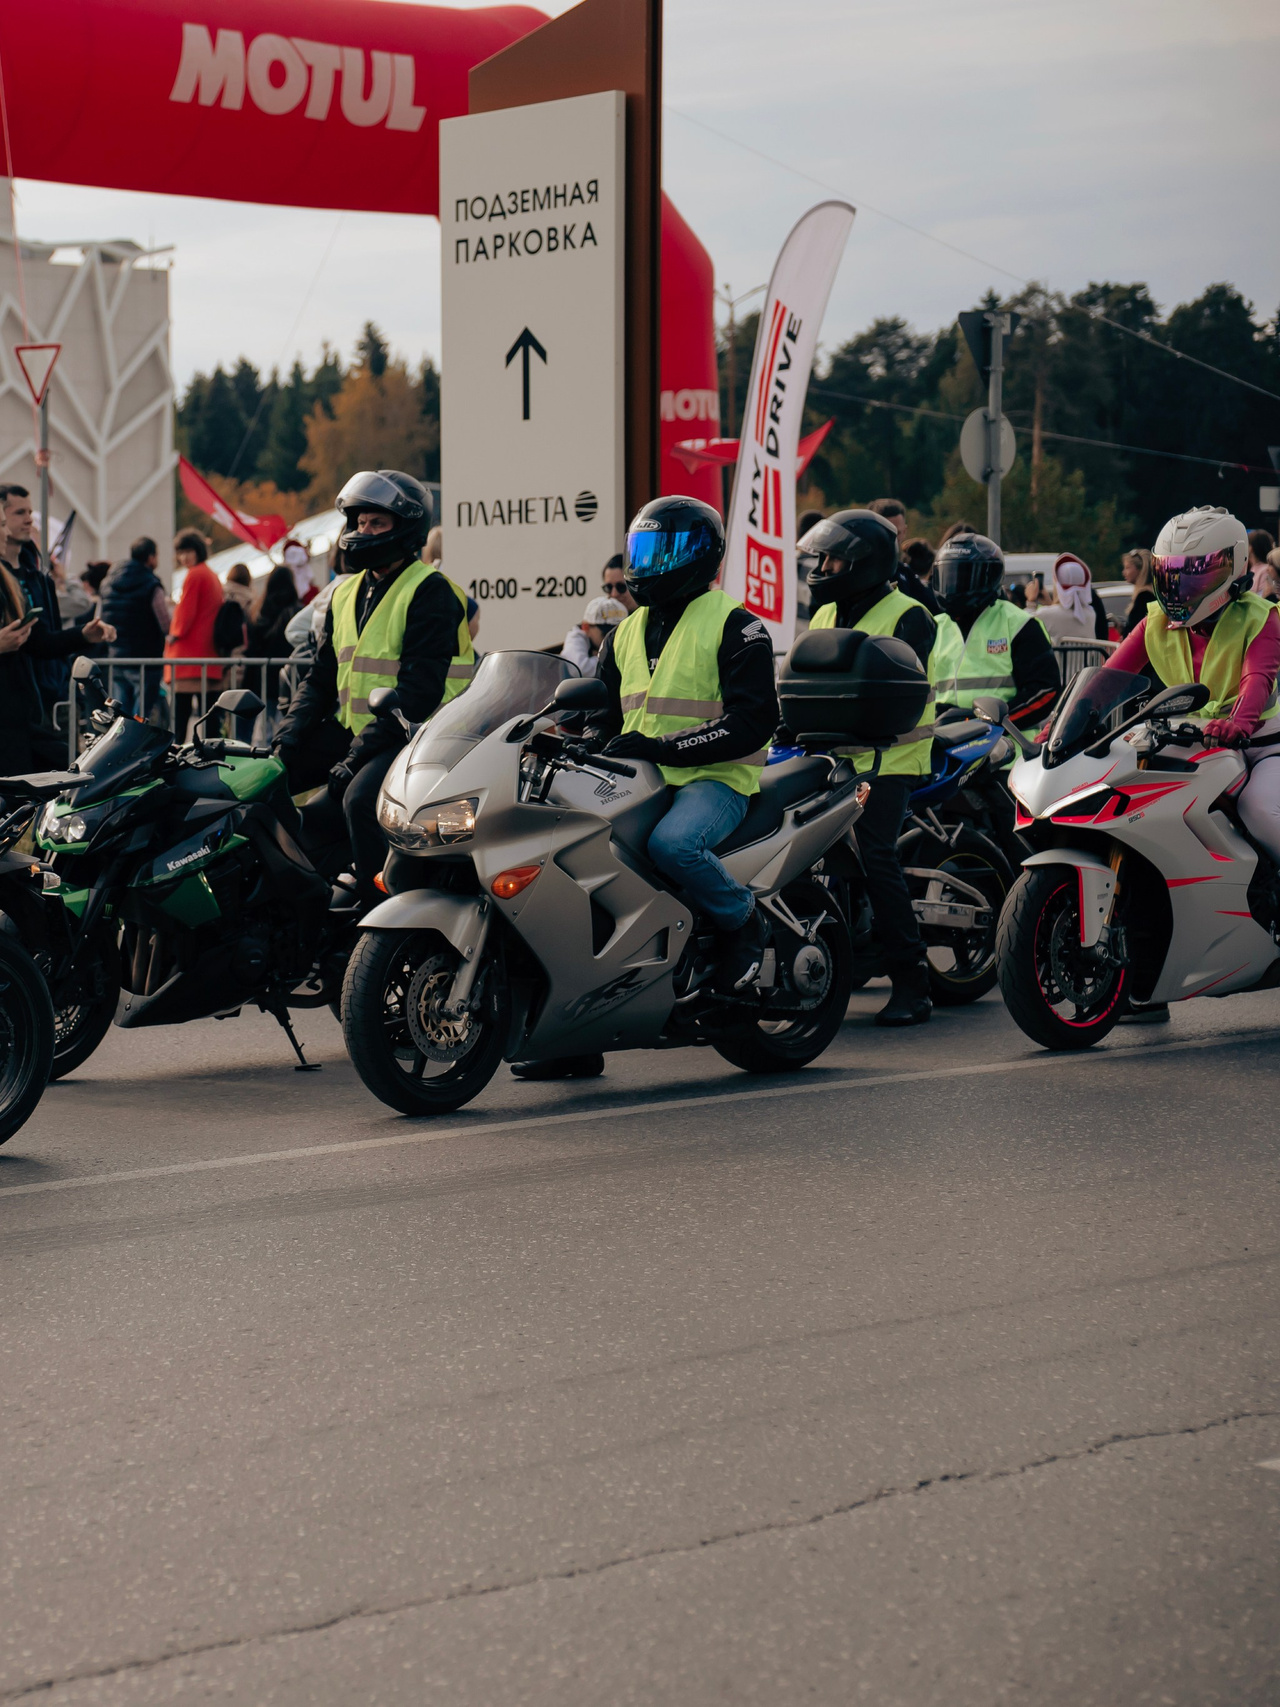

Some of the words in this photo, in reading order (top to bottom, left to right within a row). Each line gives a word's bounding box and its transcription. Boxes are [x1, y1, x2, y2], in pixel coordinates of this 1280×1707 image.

[169, 22, 427, 132] MOTUL
[455, 178, 599, 222] ПОДЗЕМНАЯ
[455, 221, 598, 264] ПАРКОВКА
[747, 453, 762, 528] MY
[765, 311, 803, 460] DRIVE
[457, 496, 568, 527] ПЛАНЕТА
[469, 577, 518, 600] 10:00
[535, 576, 587, 598] 22:00
[743, 632, 770, 643] HONDA
[676, 728, 730, 751] HONDA
[600, 789, 633, 806] HONDA
[166, 845, 211, 871] Kawasaki
